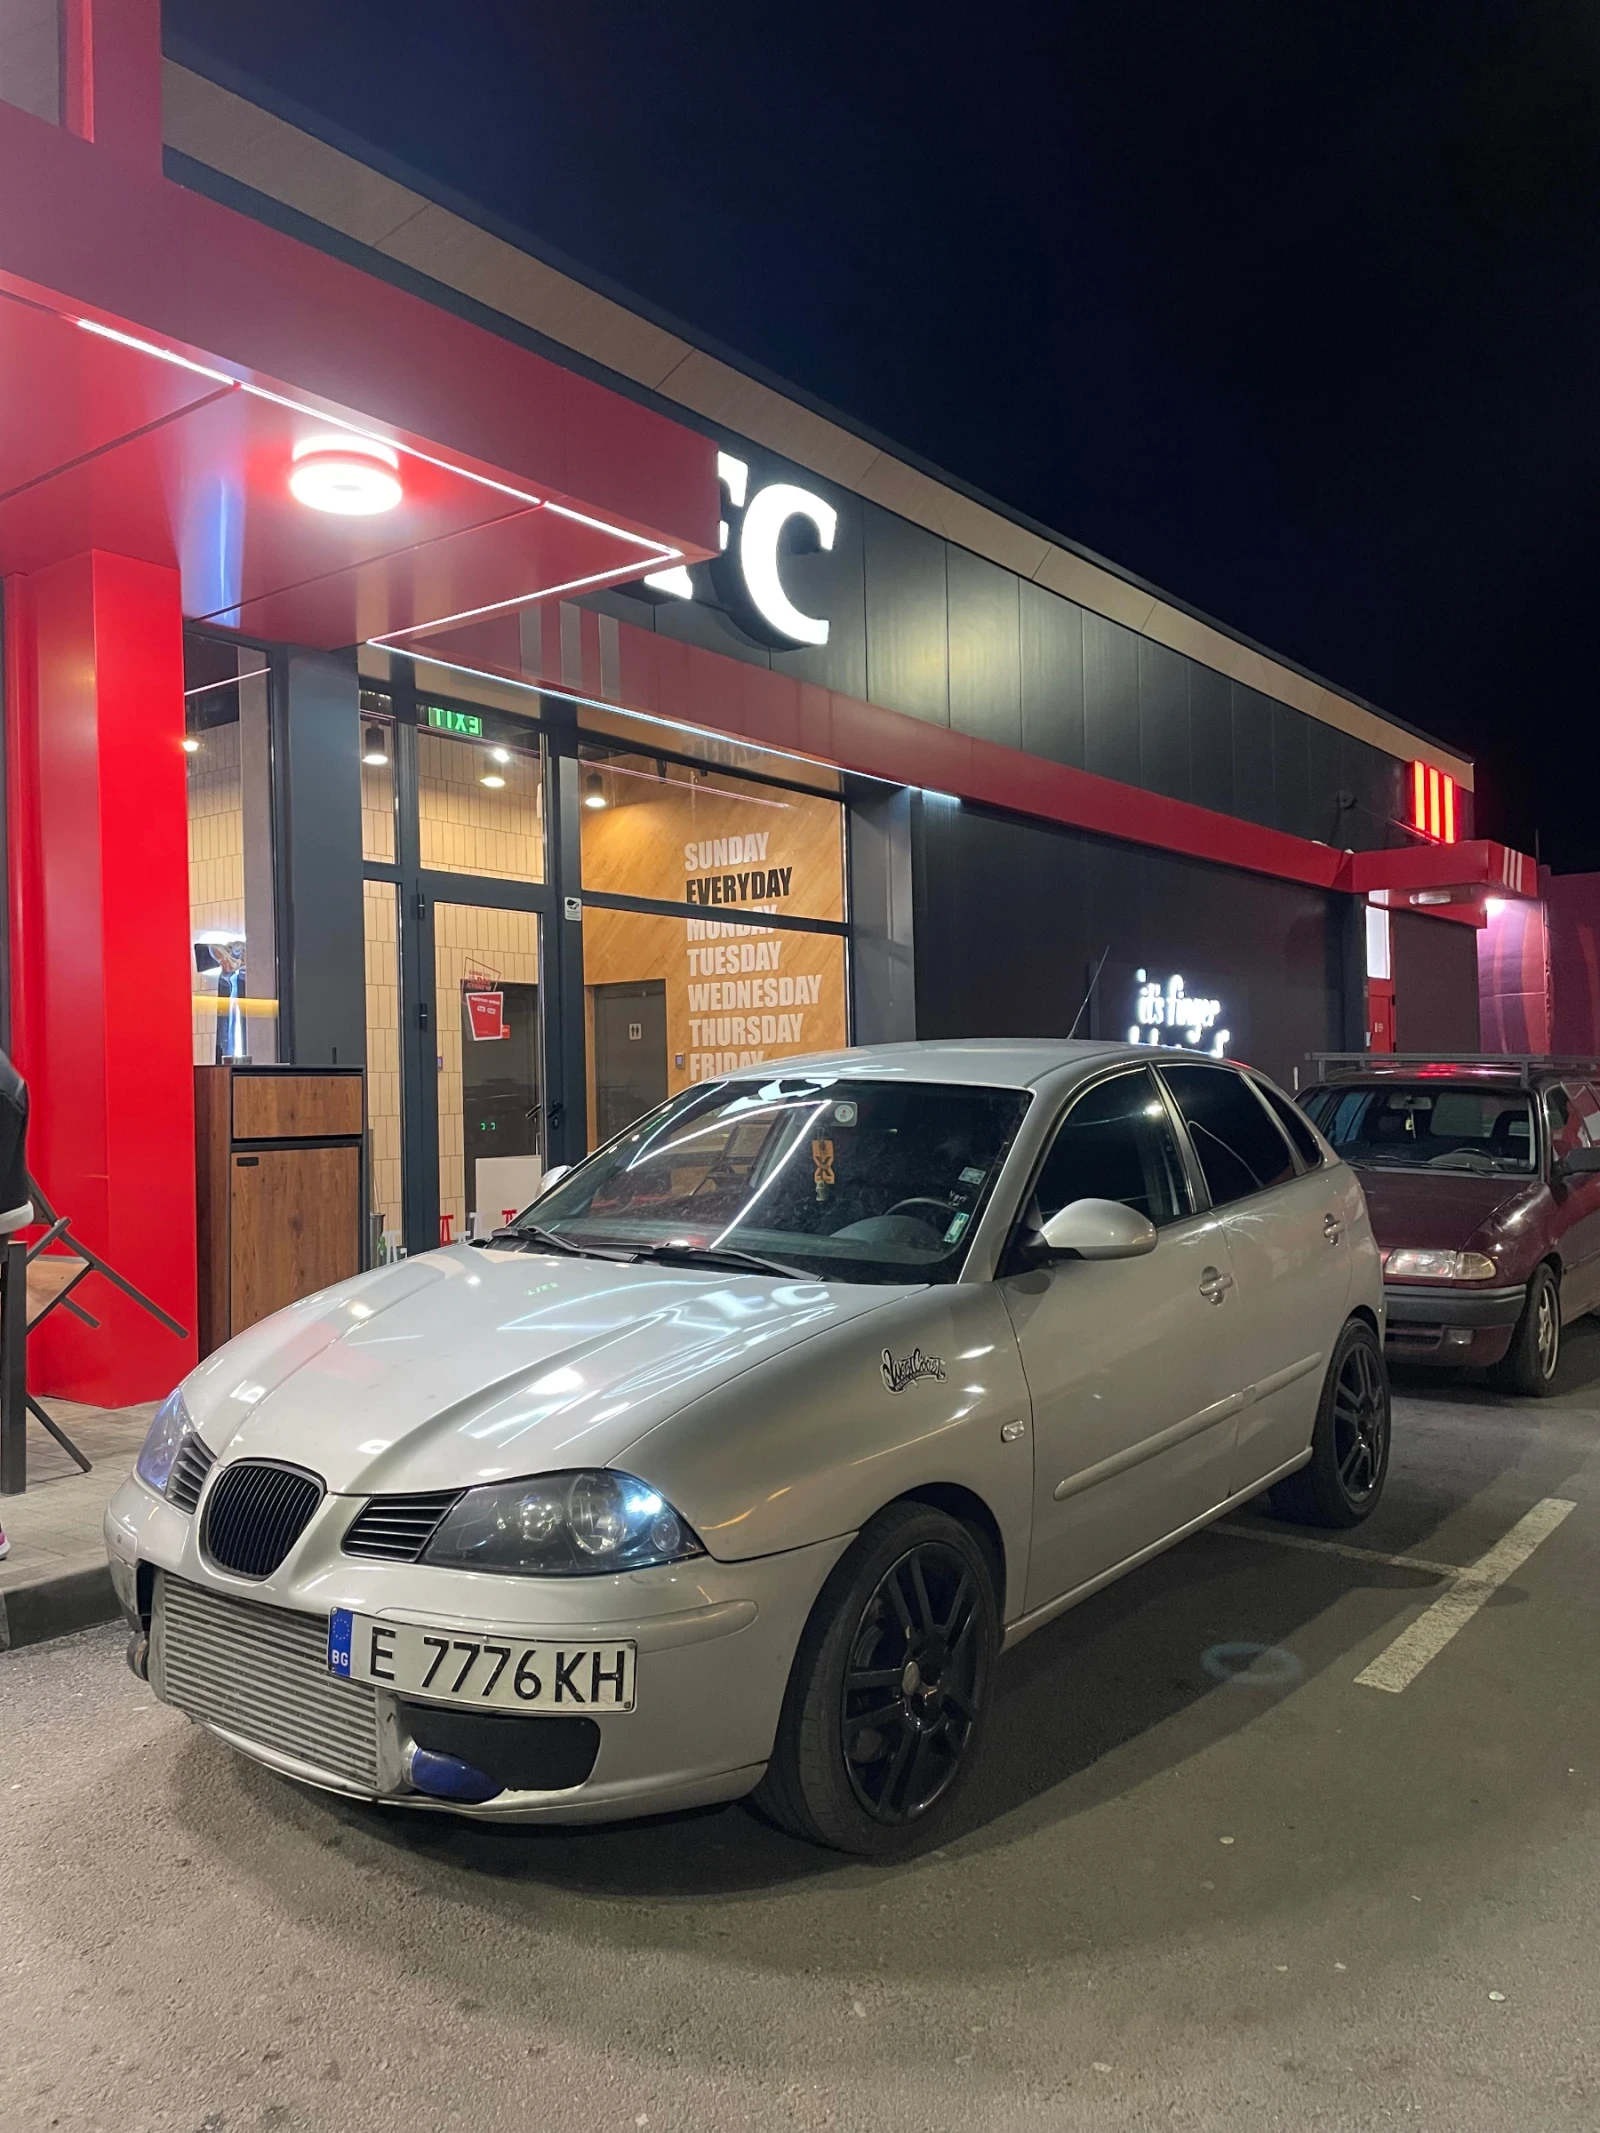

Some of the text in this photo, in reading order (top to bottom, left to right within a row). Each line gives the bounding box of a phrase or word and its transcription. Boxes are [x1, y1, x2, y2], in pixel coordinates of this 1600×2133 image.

[684, 832, 769, 872] SUNDAY
[686, 867, 793, 905] EVERYDAY
[687, 941, 782, 977] TUESDAY
[687, 975, 822, 1012] WEDNESDAY
[689, 1013, 804, 1048] THURSDAY
[331, 1651, 349, 1667] BG
[370, 1626, 396, 1681] E
